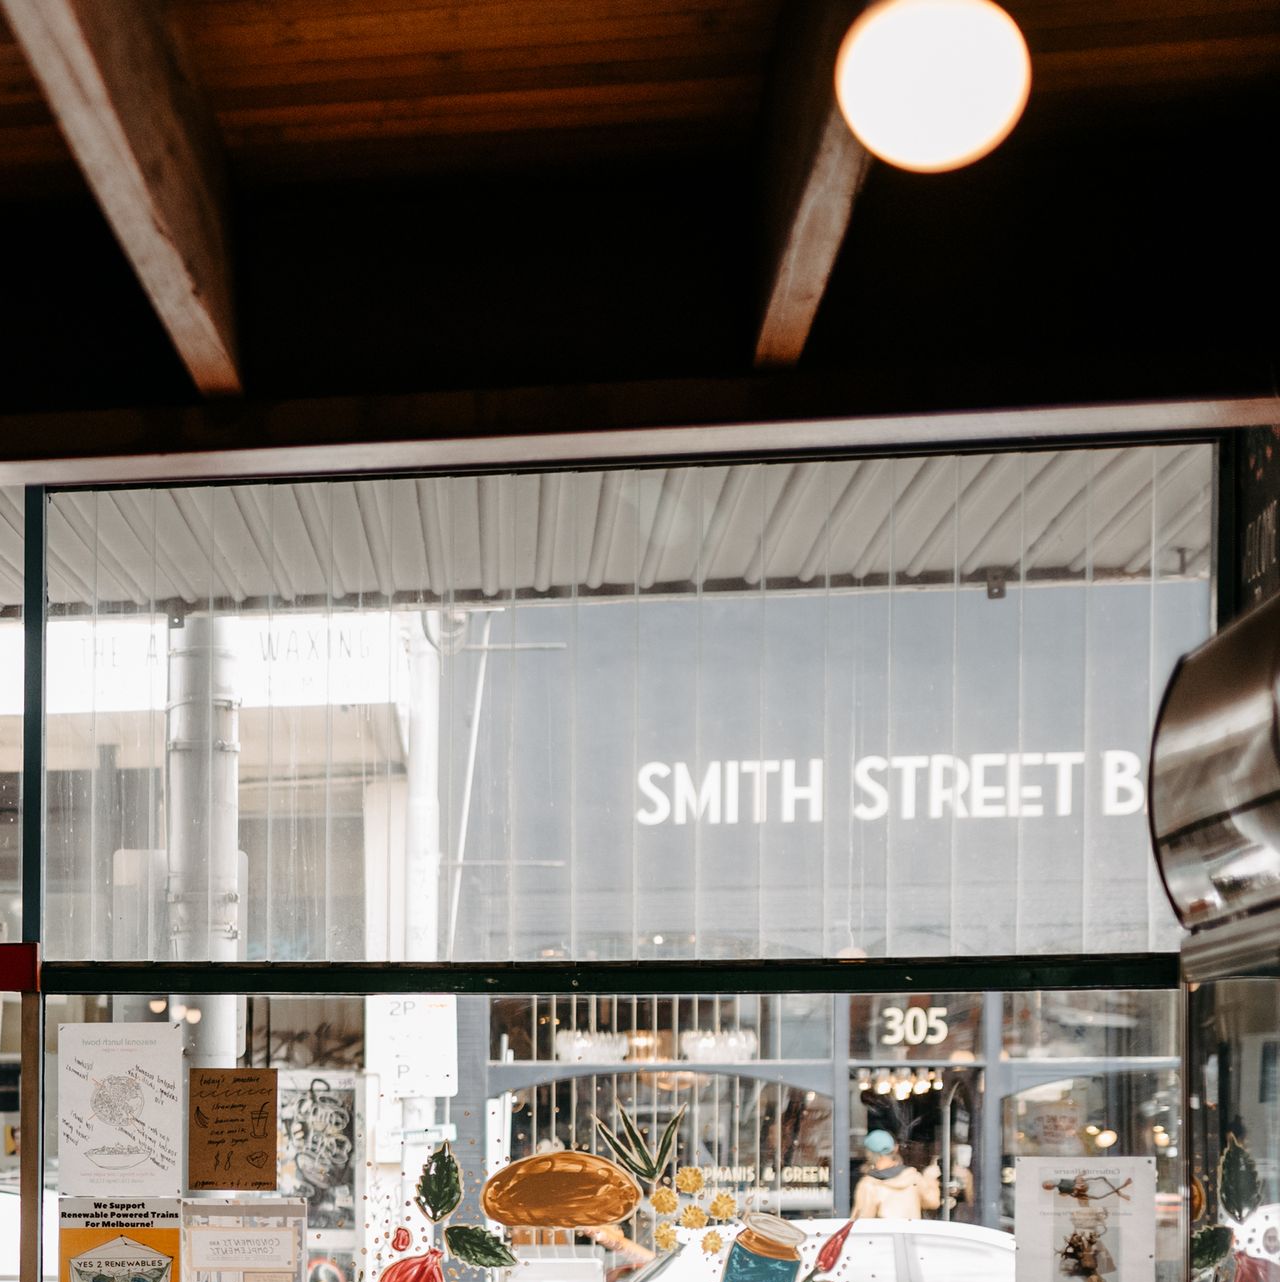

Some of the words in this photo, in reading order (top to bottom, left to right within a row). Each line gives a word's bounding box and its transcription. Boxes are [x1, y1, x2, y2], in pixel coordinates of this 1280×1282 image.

[637, 758, 823, 826] SMITH
[854, 752, 1085, 821] STREET
[1102, 749, 1147, 818] B
[882, 1007, 948, 1045] 305
[703, 1166, 755, 1182] PMANIS
[781, 1166, 830, 1182] GREEN
[109, 1202, 145, 1211] Support
[104, 1260, 163, 1268] RENEWABLES
